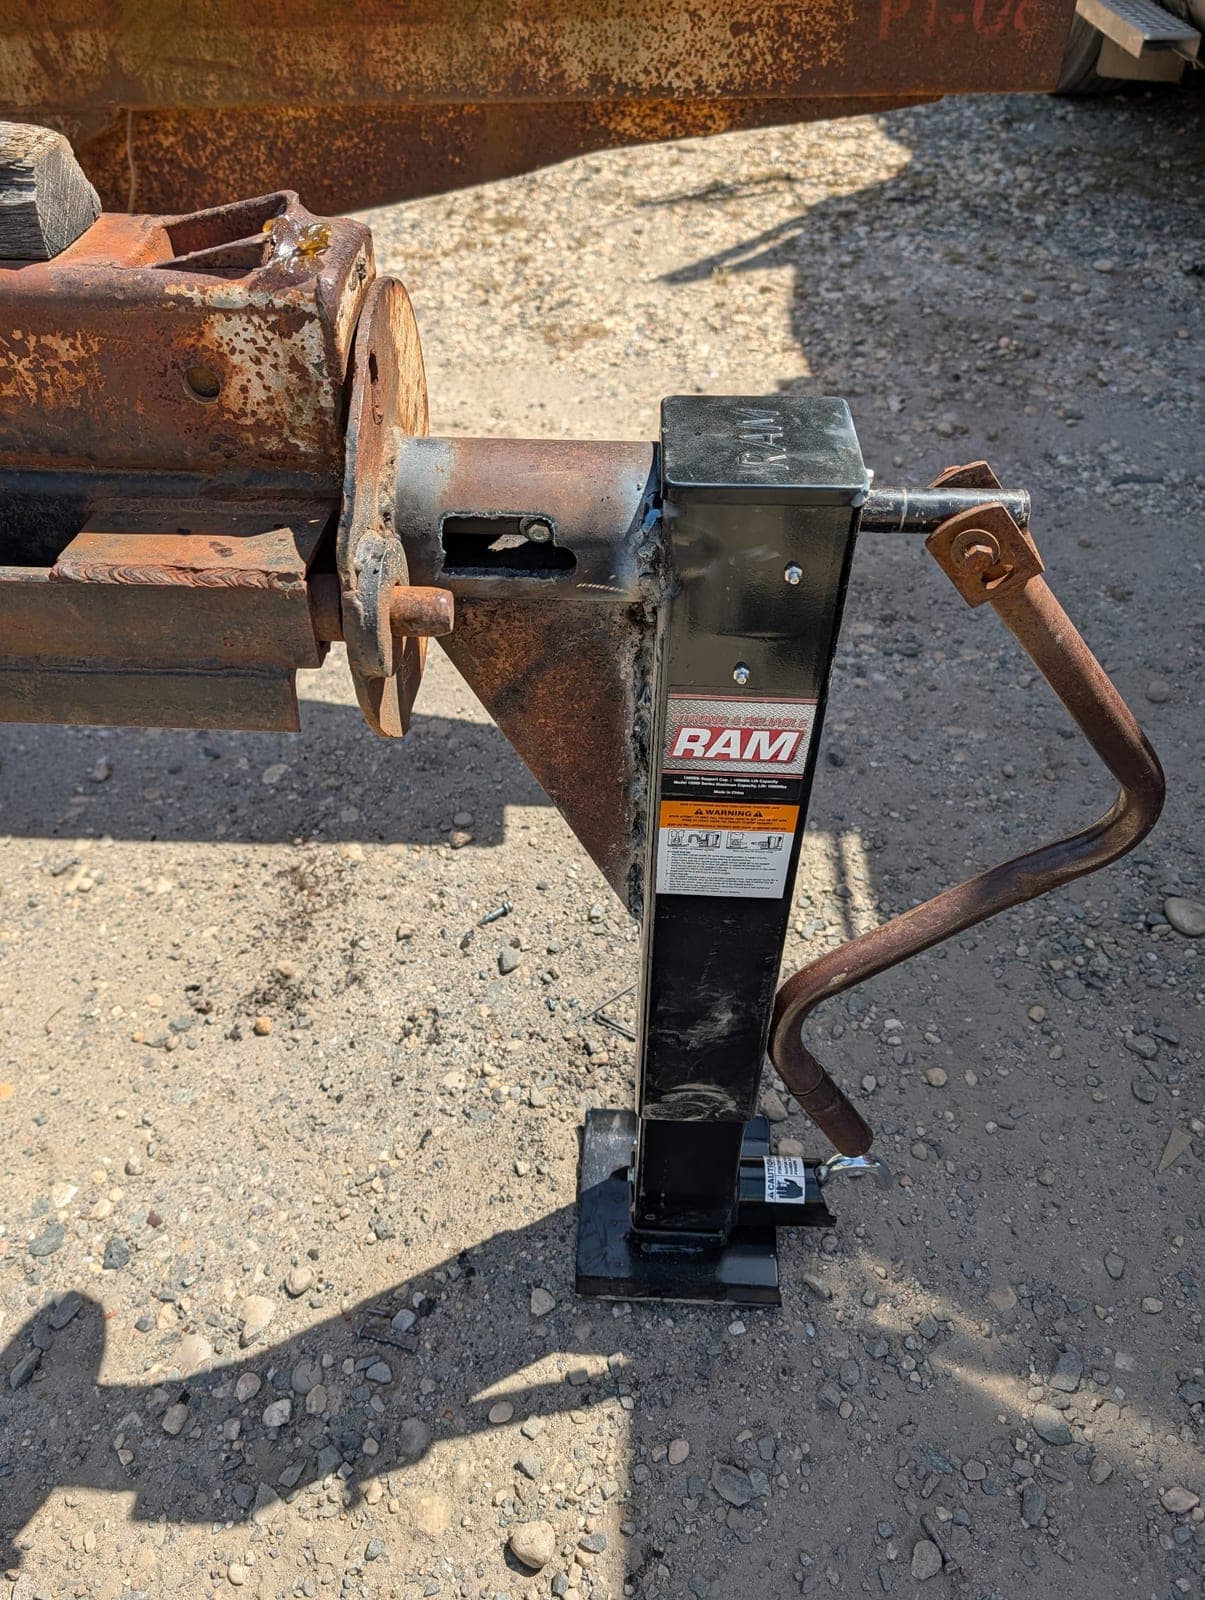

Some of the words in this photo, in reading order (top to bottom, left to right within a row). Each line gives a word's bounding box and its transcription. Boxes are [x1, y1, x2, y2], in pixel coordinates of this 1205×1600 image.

[735, 408, 789, 474] RAM
[672, 727, 800, 761] RAM
[705, 808, 752, 817] WARNING
